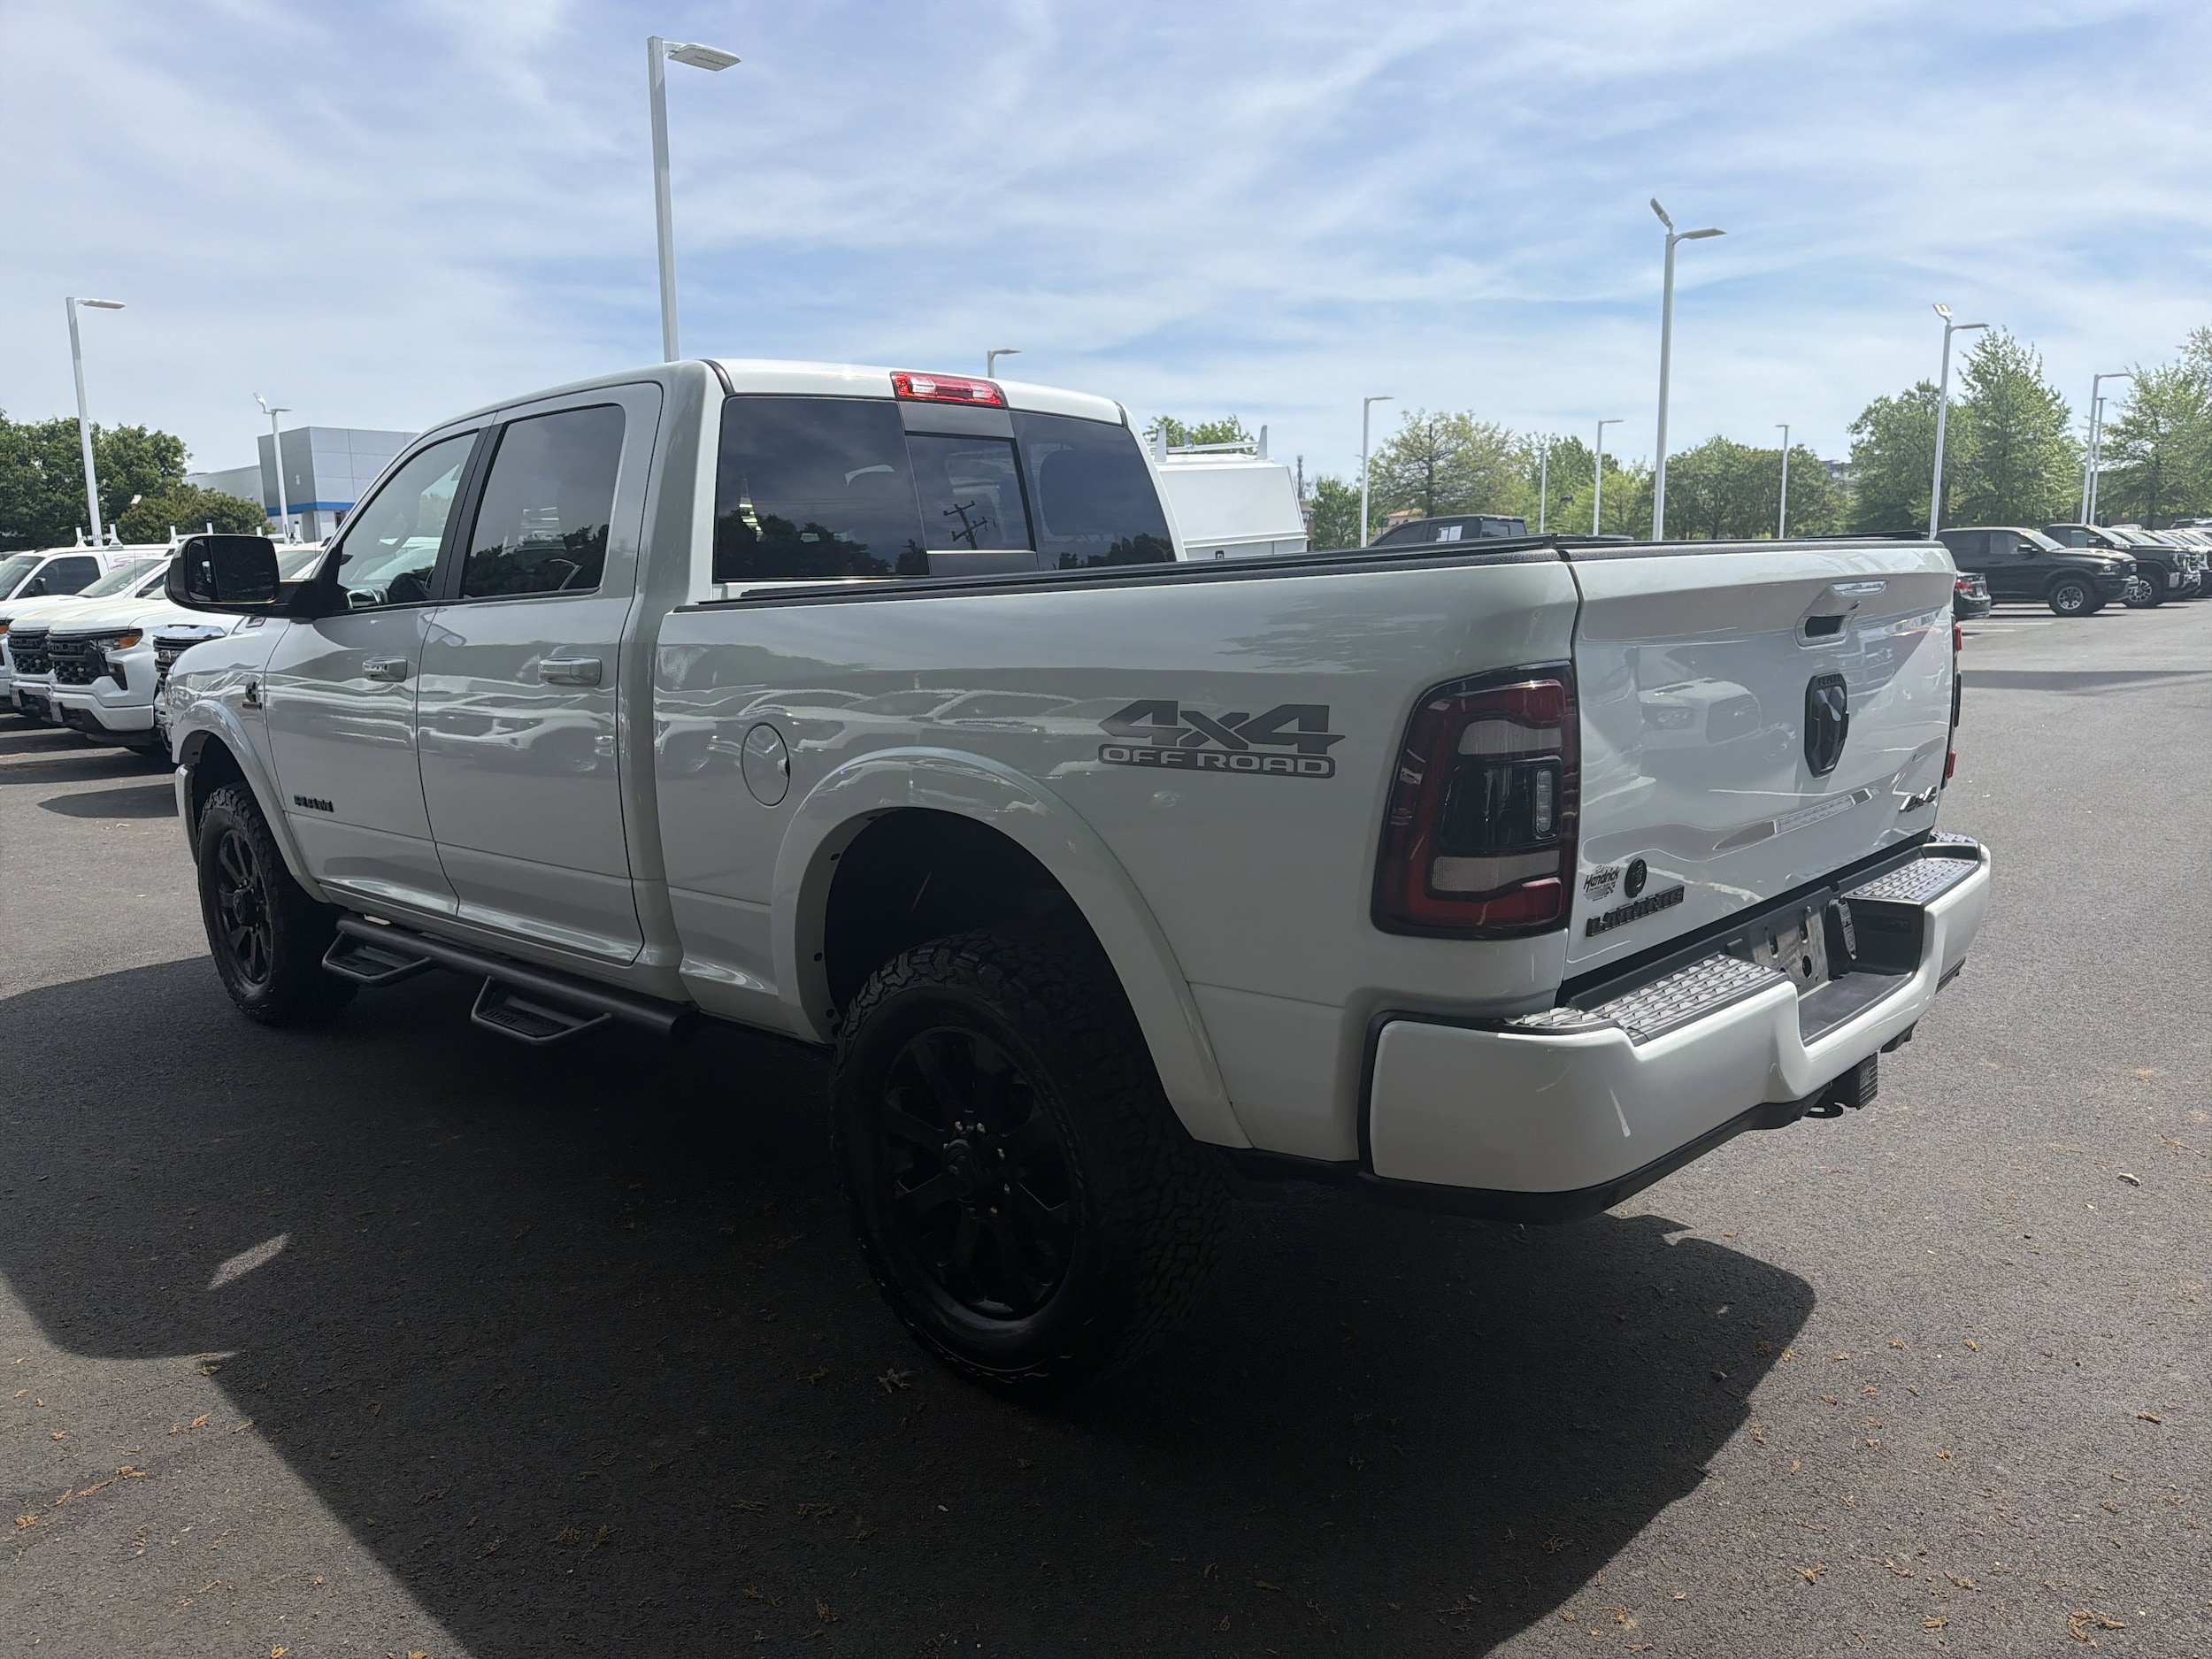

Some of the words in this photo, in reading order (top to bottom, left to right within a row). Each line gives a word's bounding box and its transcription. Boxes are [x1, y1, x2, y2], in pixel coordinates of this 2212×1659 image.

[1102, 747, 1187, 765] OFF
[1196, 752, 1330, 775] ROAD
[1583, 866, 1620, 893] Hendrick
